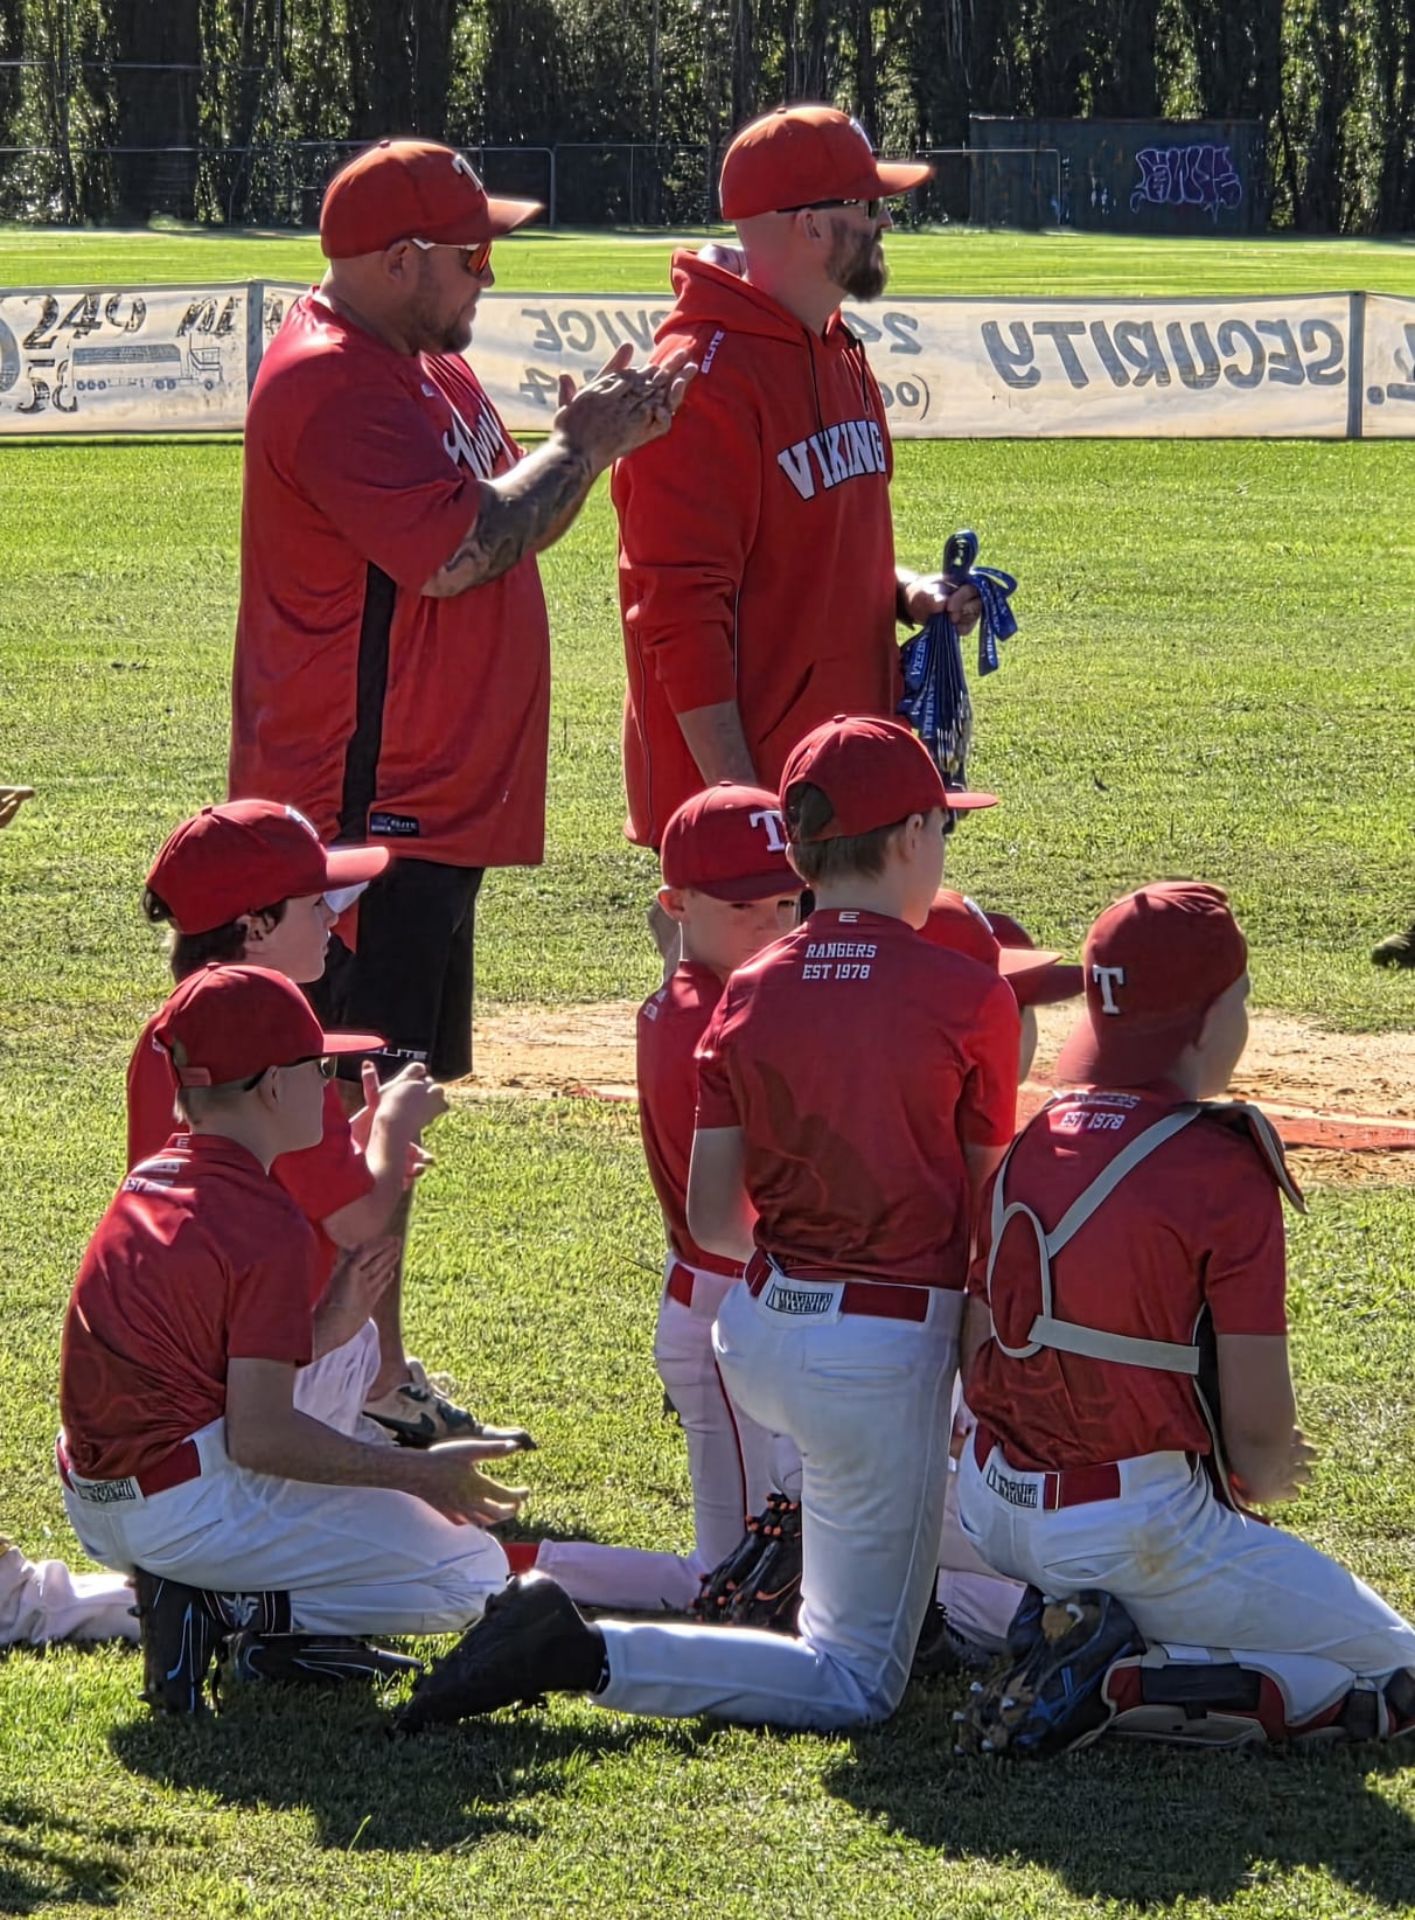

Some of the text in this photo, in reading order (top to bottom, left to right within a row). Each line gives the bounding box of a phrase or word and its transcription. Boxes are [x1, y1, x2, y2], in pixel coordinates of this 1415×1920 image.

[749, 810, 786, 852] T
[804, 942, 878, 959] RANGERS
[802, 963, 871, 980] EST 1978
[1092, 963, 1125, 1015] T
[1087, 1111, 1126, 1130] 1978
